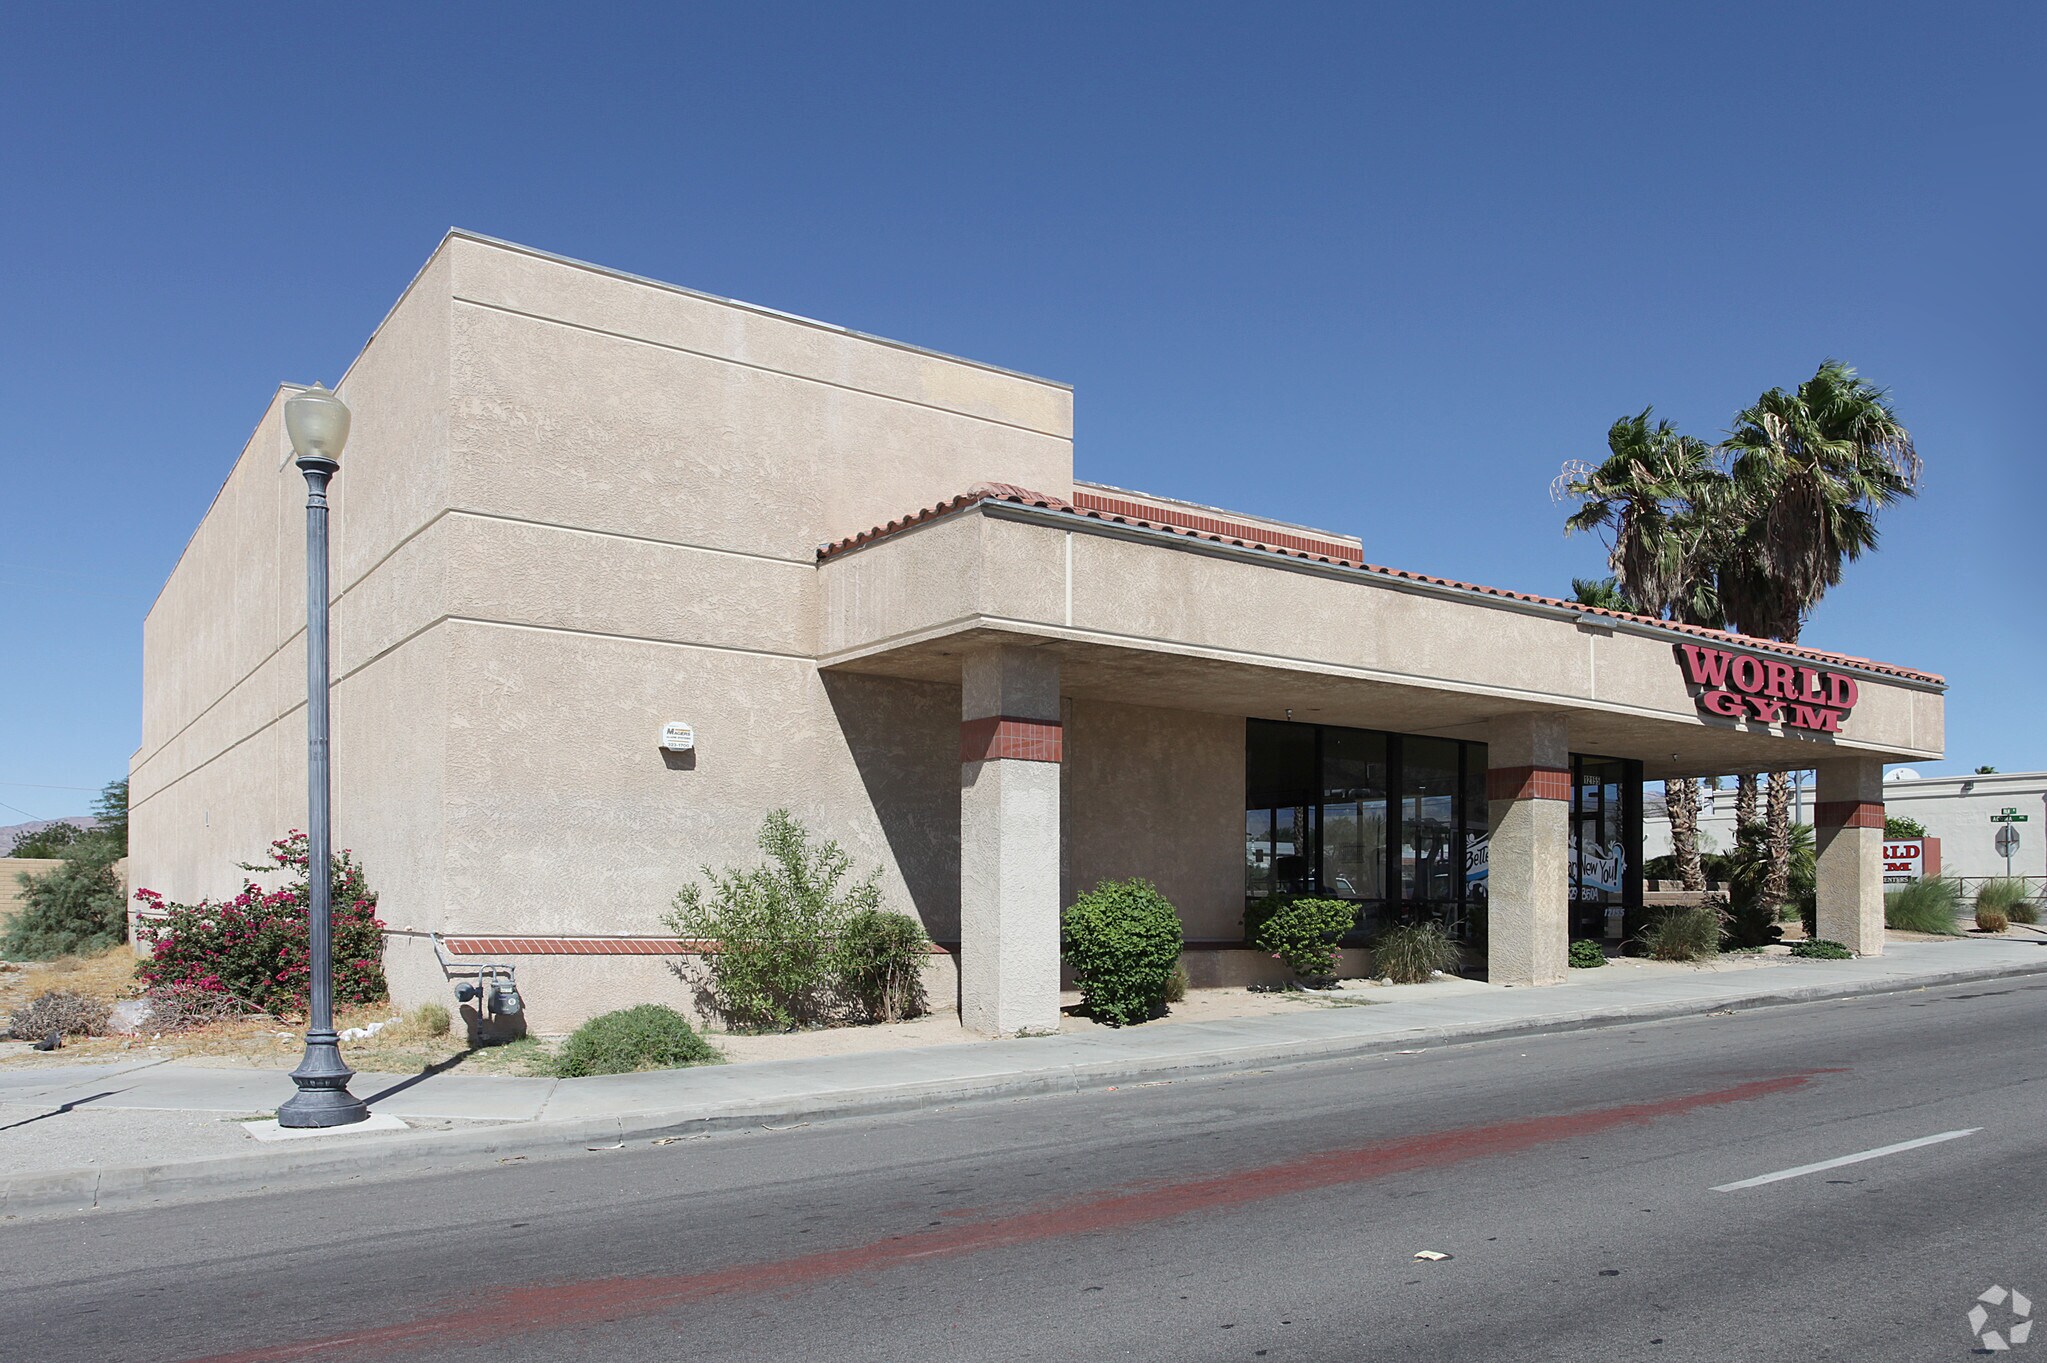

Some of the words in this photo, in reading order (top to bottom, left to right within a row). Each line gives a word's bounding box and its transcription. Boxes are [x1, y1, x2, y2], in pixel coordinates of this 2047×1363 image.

[1681, 643, 1859, 709] WORLD
[1703, 690, 1843, 733] GYM
[1583, 774, 1601, 786] 12155
[1465, 845, 1489, 872] Bette
[1883, 844, 1920, 860] RLD
[1581, 854, 1598, 876] New
[1599, 857, 1618, 887] You!
